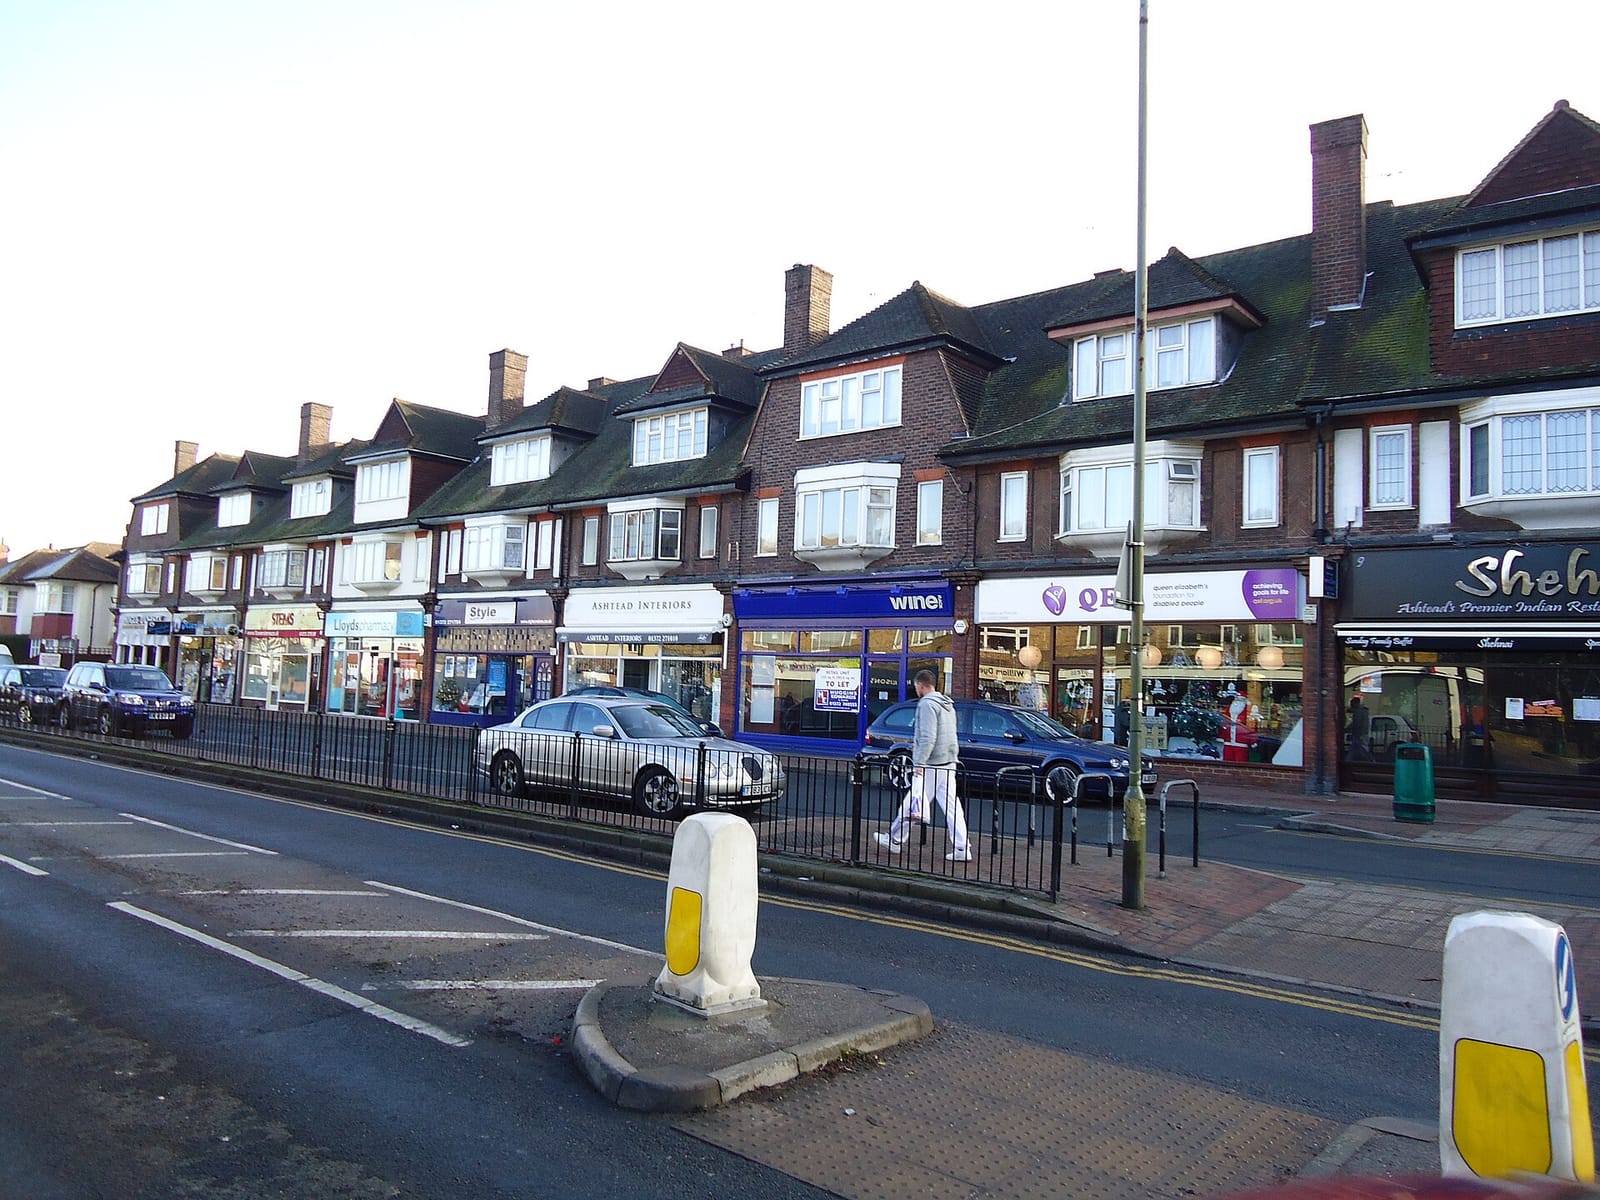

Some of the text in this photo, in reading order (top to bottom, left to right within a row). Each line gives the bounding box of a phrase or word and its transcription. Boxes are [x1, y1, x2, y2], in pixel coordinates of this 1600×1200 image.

[1355, 556, 1365, 568] 9
[592, 600, 692, 611] ASHTEAD INTERIORS
[889, 594, 939, 610] wine
[1181, 600, 1205, 608] people
[1397, 600, 1456, 614] Ashtead's
[1459, 601, 1512, 613] Premier
[1515, 600, 1562, 612] Indian
[272, 612, 295, 626] STEMS
[470, 607, 497, 620] Style
[586, 634, 609, 642] ASHTEAD
[614, 634, 642, 642] INTERIORS
